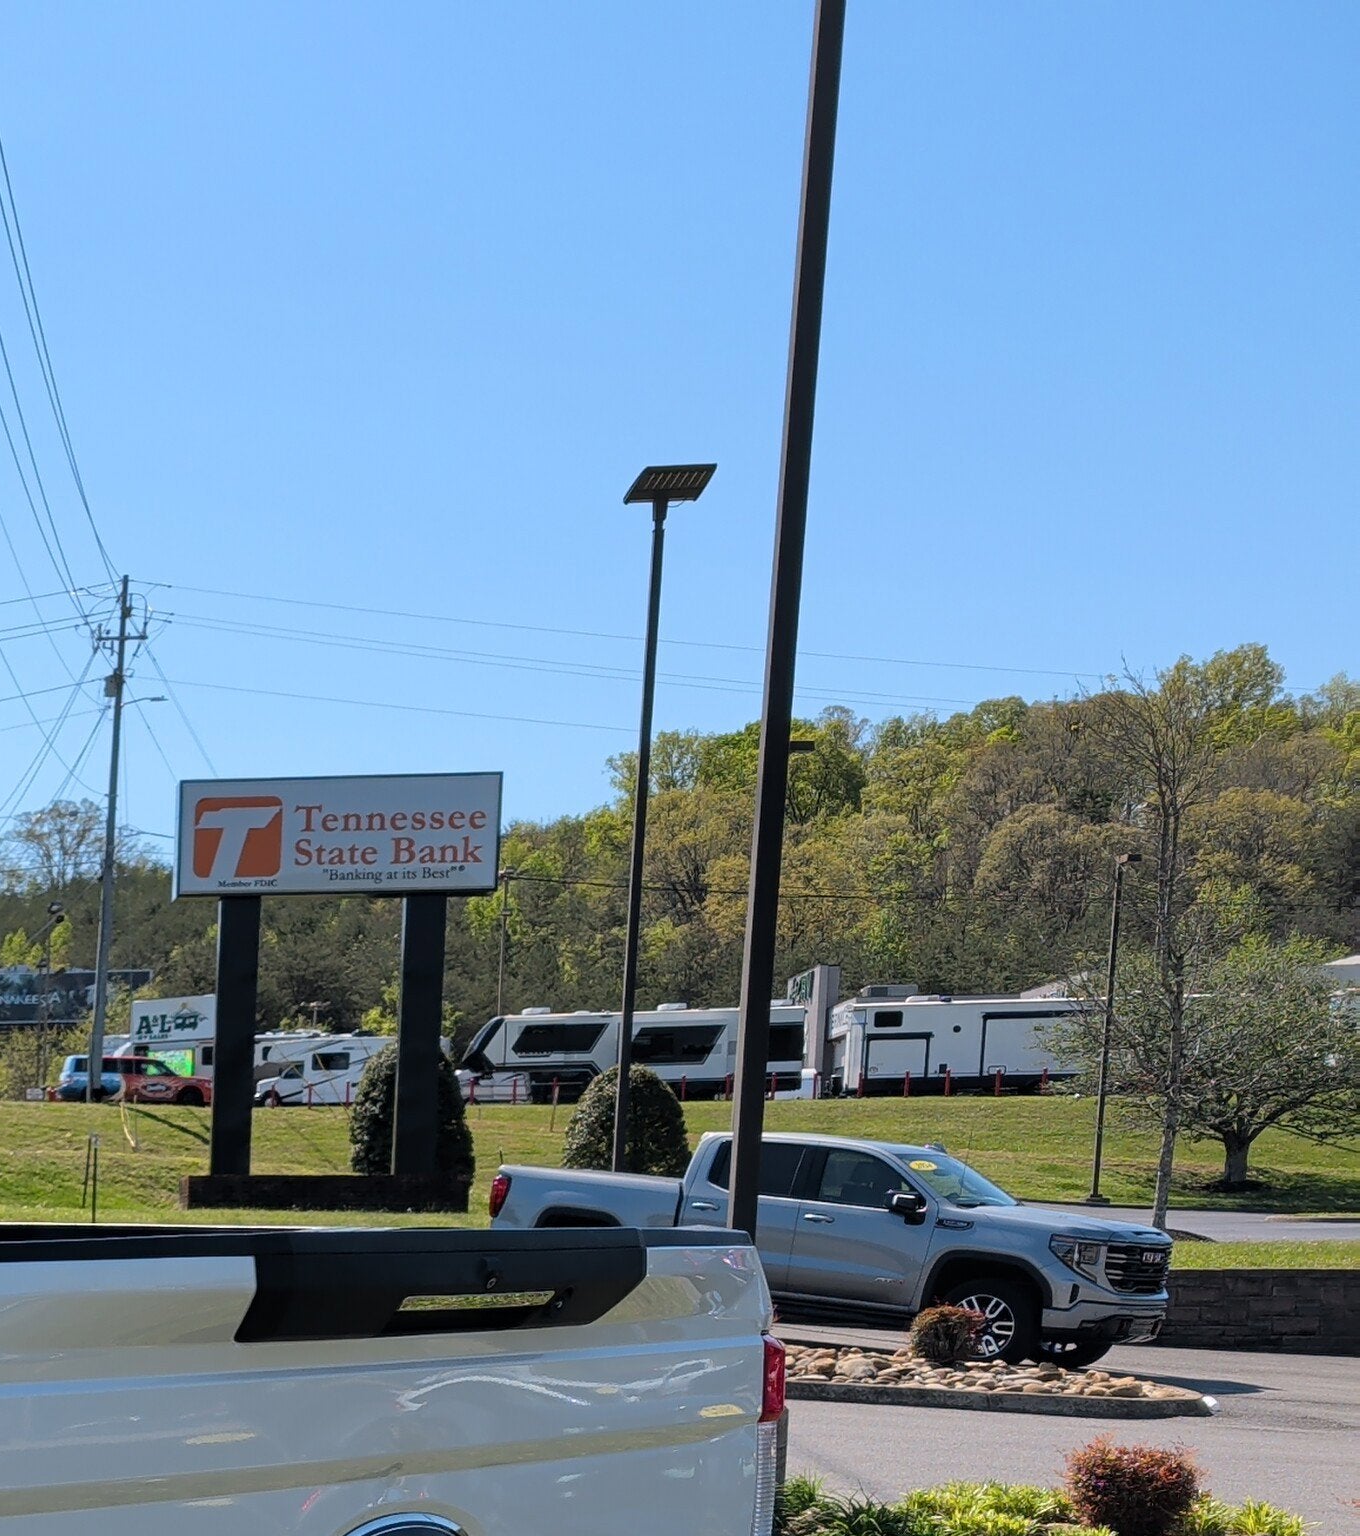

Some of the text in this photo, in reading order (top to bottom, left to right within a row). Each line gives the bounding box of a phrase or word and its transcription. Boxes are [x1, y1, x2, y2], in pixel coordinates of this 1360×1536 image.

[294, 804, 487, 833] Tennessee
[294, 836, 484, 867] State Bank
[217, 878, 279, 888] Member FDIC
[386, 869, 399, 880] at
[402, 867, 418, 880] its
